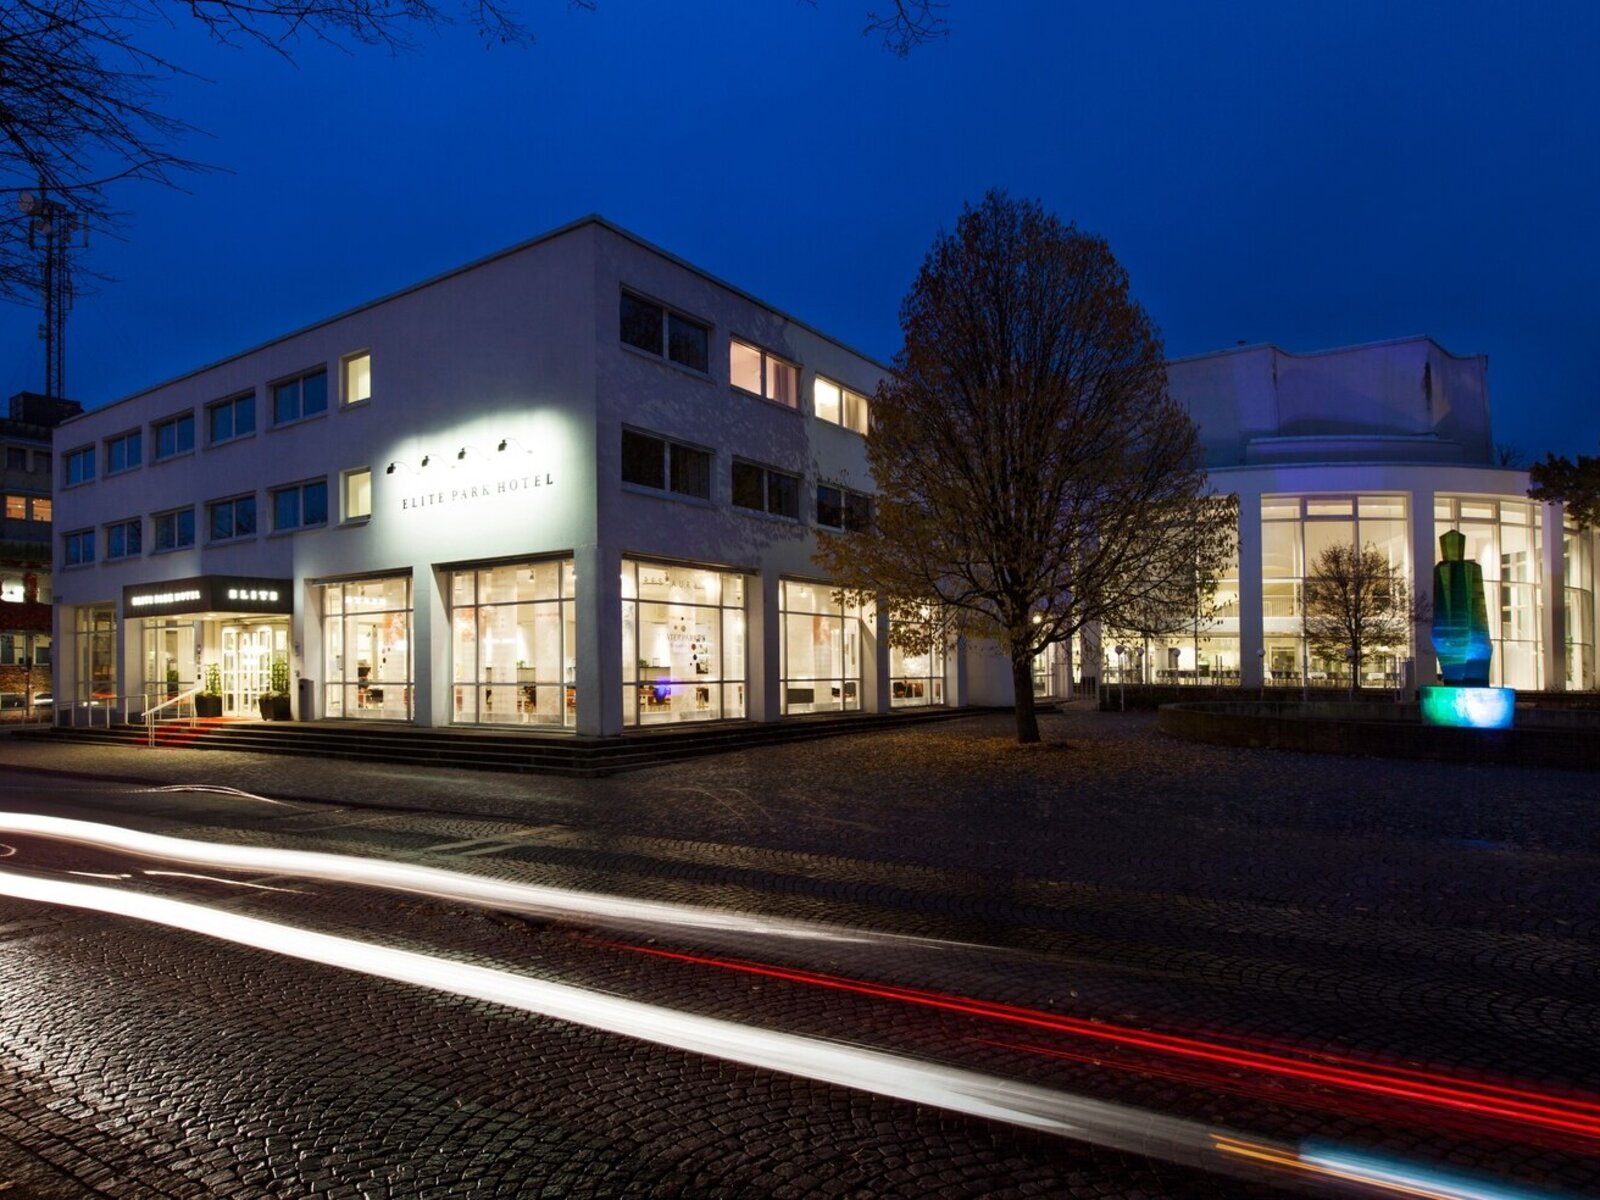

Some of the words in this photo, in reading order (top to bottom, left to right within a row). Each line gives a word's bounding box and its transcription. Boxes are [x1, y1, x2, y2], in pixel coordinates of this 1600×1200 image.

[402, 493, 445, 510] ELITE
[451, 486, 490, 501] PARK
[497, 473, 554, 494] HOTEL
[228, 589, 278, 601] ELITE
